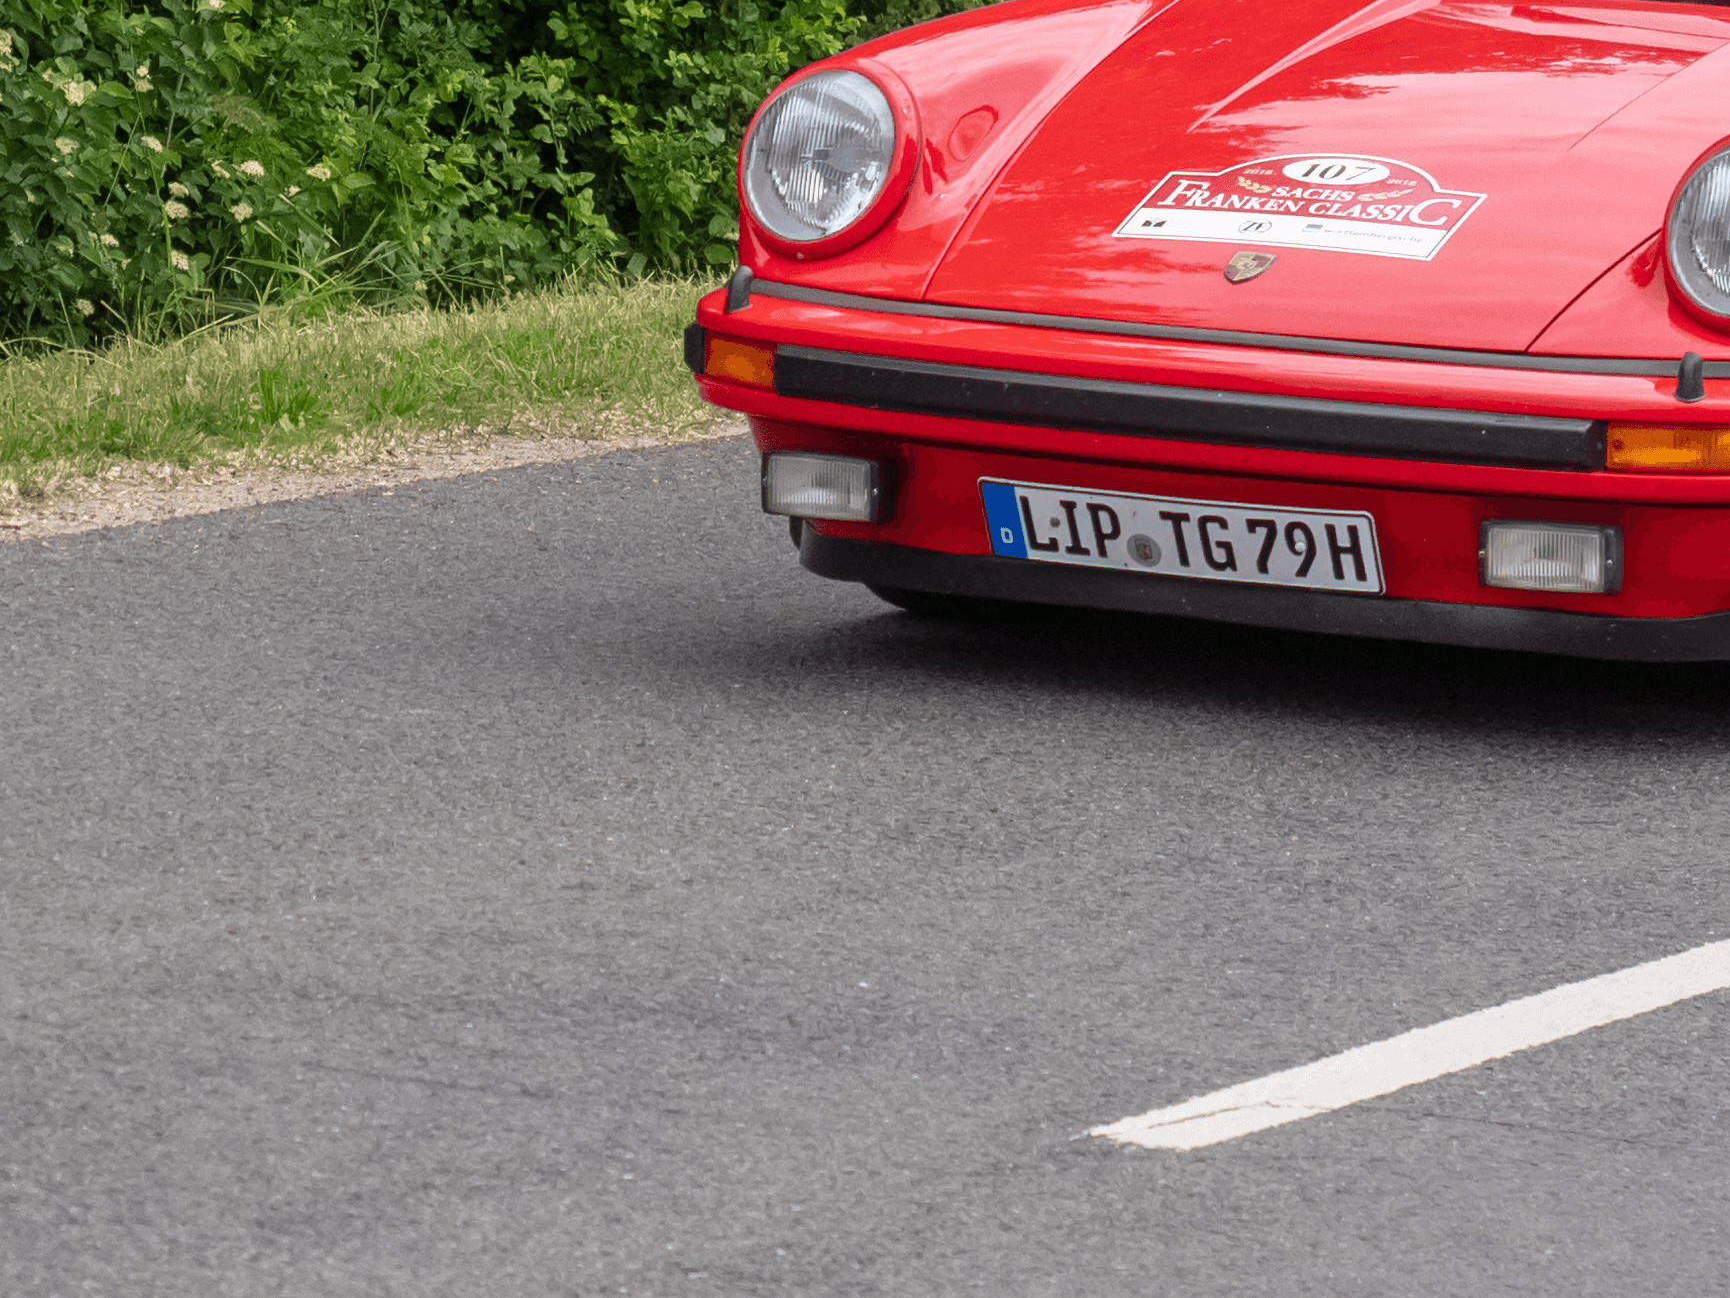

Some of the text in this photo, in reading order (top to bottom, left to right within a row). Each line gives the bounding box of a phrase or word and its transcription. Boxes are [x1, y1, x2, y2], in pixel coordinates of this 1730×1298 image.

[1300, 163, 1376, 182] 107
[1157, 179, 1462, 226] FRANKEN CLASSIC
[1271, 186, 1356, 202] SACHS
[1000, 527, 1014, 544] D
[1019, 495, 1121, 558] LIP
